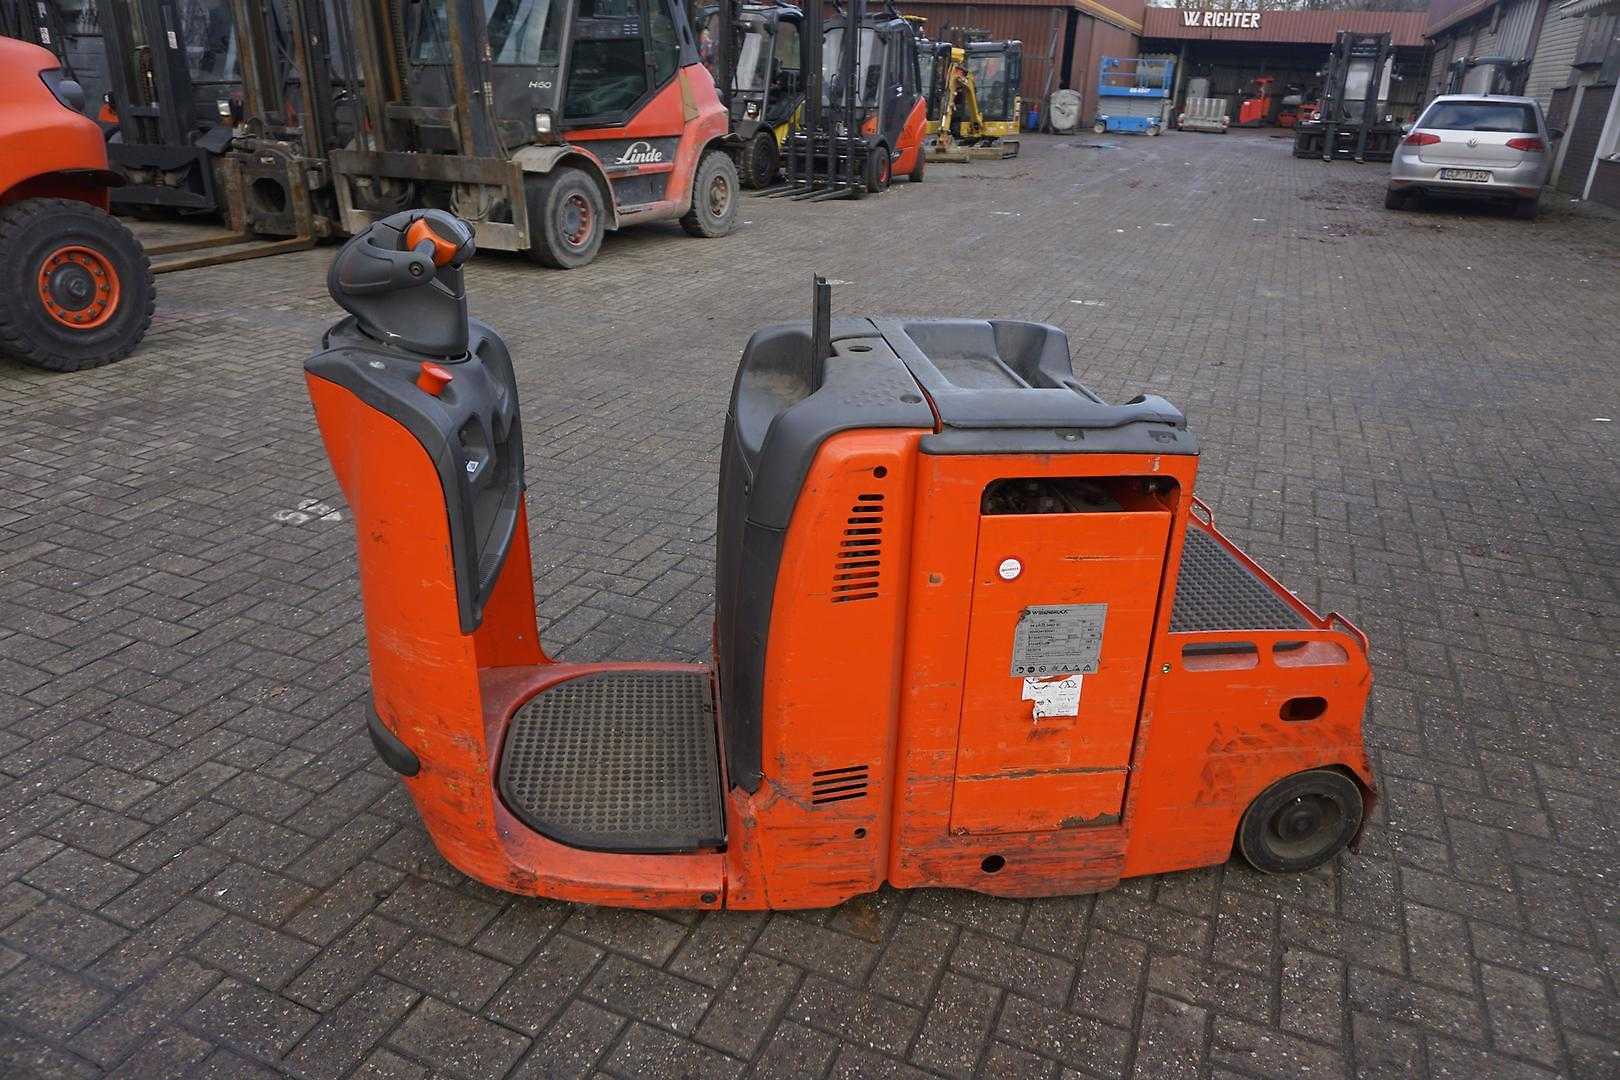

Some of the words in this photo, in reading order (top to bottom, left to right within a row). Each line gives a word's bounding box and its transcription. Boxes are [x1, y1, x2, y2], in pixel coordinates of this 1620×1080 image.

[1183, 11, 1200, 26] W.
[1203, 11, 1261, 28] RICHTER
[615, 141, 662, 165] Linde
